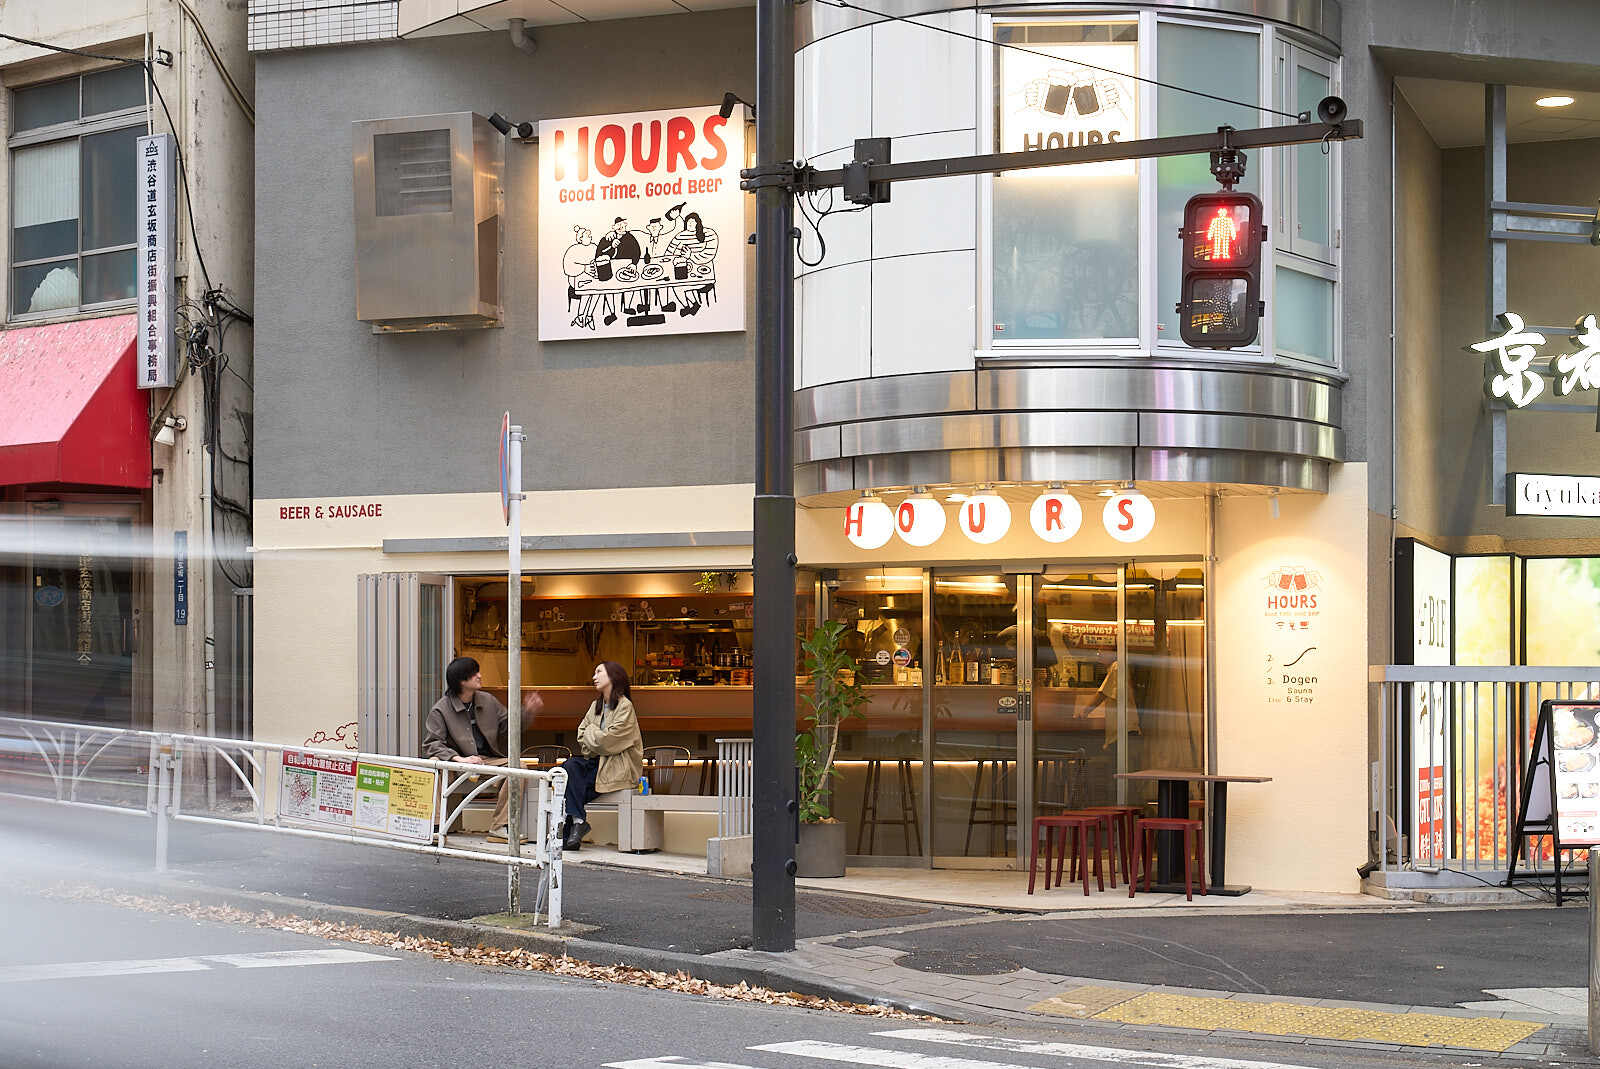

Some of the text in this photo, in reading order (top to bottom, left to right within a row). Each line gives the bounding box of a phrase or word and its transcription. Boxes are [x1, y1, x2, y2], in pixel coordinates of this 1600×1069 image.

[554, 114, 728, 182] HOURS
[559, 177, 723, 203] Good Time, Good Beer
[147, 159, 158, 382] 渋谷道玄坂商店街振興組合事務局
[280, 503, 383, 520] BEER & SAUSAGE
[844, 498, 1134, 537] HOURS
[1267, 594, 1318, 609] HOURS
[1283, 674, 1318, 685] Dogen
[1295, 696, 1314, 705] Stay
